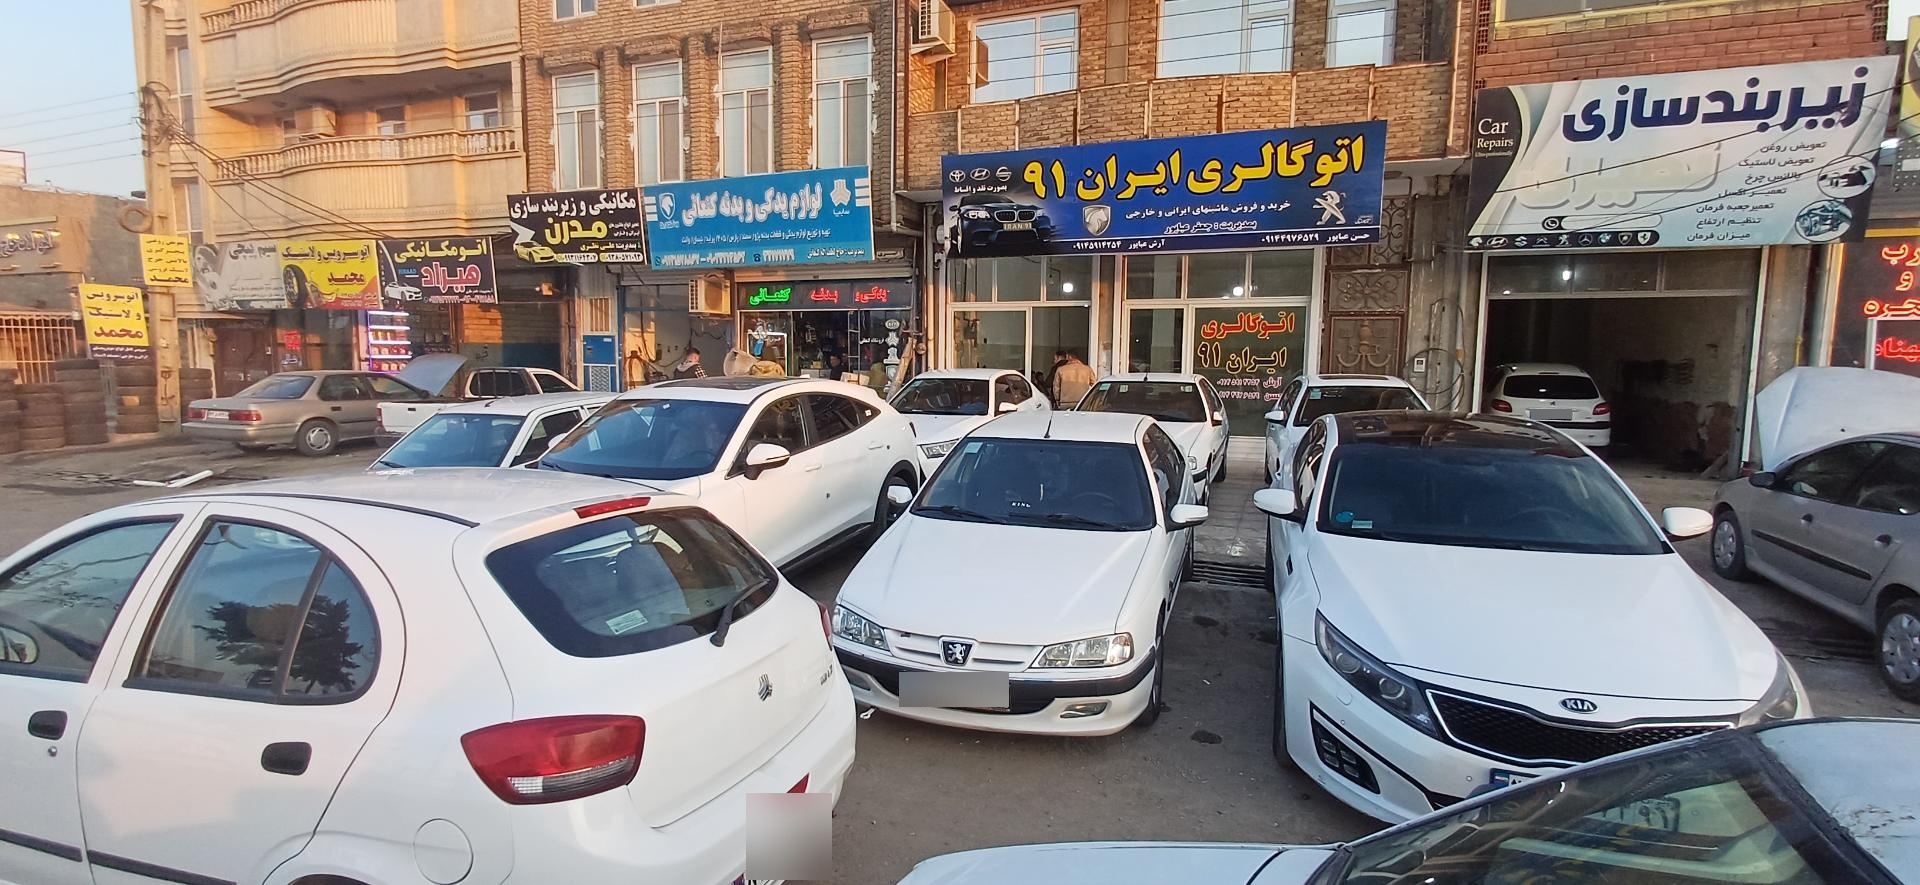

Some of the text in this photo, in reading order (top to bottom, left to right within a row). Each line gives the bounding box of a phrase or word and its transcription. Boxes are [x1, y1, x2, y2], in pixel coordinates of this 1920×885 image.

[1478, 118, 1509, 135] Car
[1476, 137, 1514, 151] Repairs
[1760, 141, 1827, 153] تعویض روغن
[1738, 157, 1815, 169] تعویض لاستیک
[1022, 159, 1066, 199] ۹۱
[1076, 149, 1183, 200] ایران
[1744, 173, 1766, 185] چرخ
[511, 196, 539, 218] سازی
[580, 199, 586, 216] و
[589, 191, 636, 215] مکانیکی
[682, 182, 822, 227] لوازم یدکی و بدنه کنعانی
[1231, 201, 1257, 214] فروش
[1260, 204, 1265, 212] و
[1267, 200, 1291, 211] خرید
[1696, 203, 1724, 214] فرمان
[833, 209, 850, 217] سایپا
[1125, 208, 1155, 219] خارجی
[1157, 210, 1162, 218] و
[1165, 206, 1191, 218] ایرانی
[1696, 217, 1762, 230] تنظیم ارتفاع
[544, 217, 608, 245] مدرن
[1350, 233, 1370, 242] حسن
[1687, 232, 1751, 242] میزان فرمان
[1882, 244, 1920, 266] رب
[150, 275, 189, 284] محمد
[327, 271, 365, 283] محمد
[421, 262, 481, 293] میراد
[1895, 271, 1914, 291] و
[750, 287, 791, 305] کنعانی
[811, 287, 839, 304] بدنه
[861, 286, 888, 304] یدکی
[94, 325, 144, 339] محمد
[1198, 341, 1287, 374] ایران ۹۱
[1565, 699, 1594, 711] KIA
